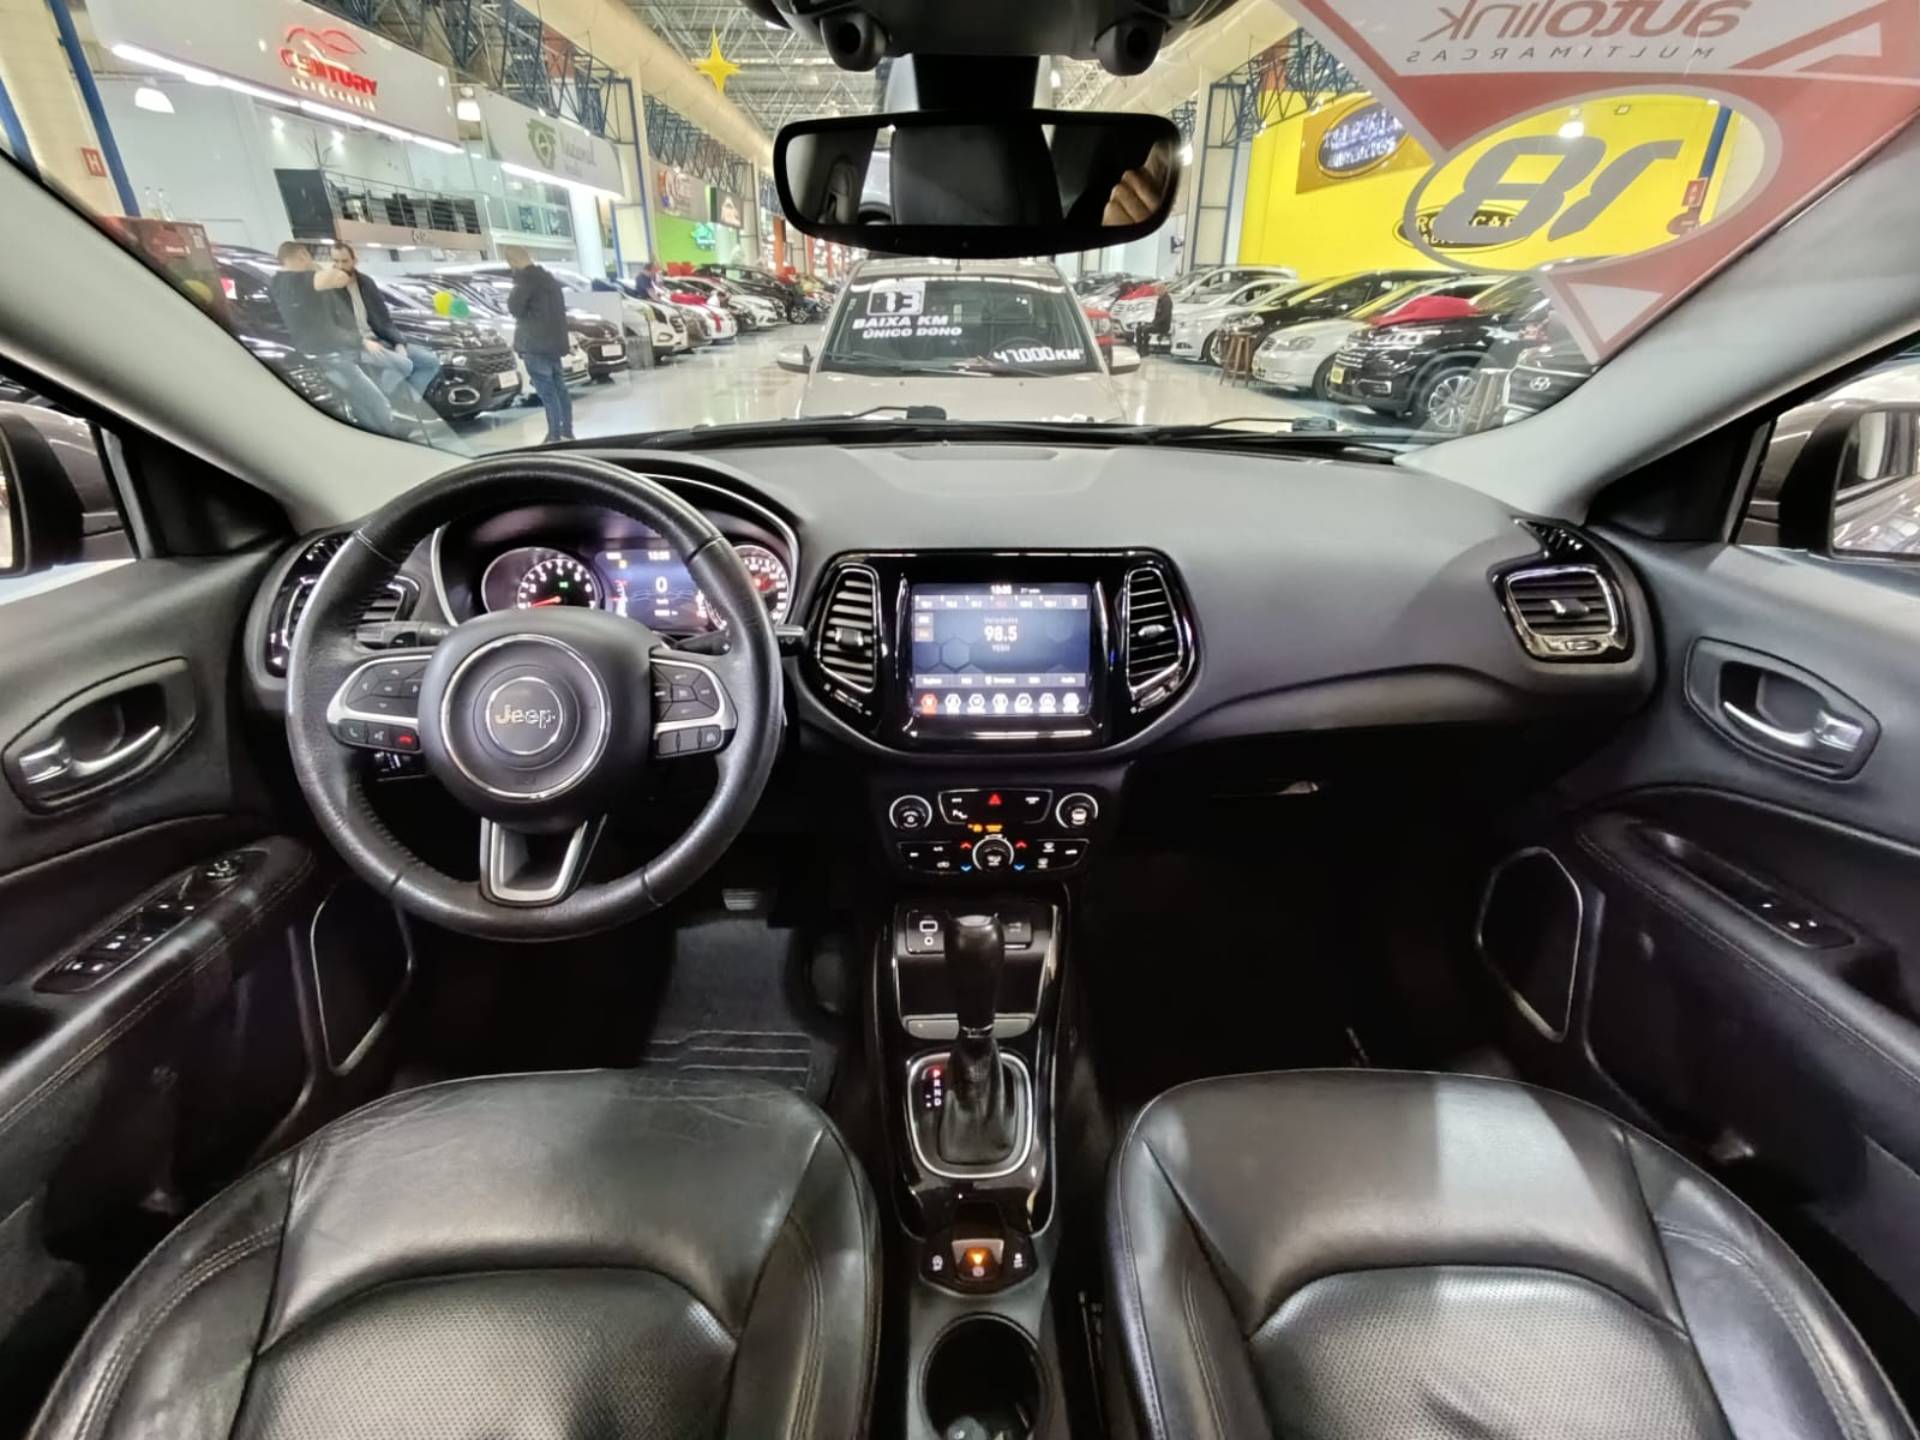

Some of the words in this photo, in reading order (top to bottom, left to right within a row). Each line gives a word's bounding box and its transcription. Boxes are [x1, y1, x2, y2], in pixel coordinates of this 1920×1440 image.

[885, 291, 922, 315] 13
[852, 316, 912, 330] BAIXA
[917, 315, 948, 326] KM
[862, 327, 913, 339] ÚNICO
[916, 326, 962, 337] DONO
[655, 575, 668, 594] 0
[984, 625, 1018, 642] 98.5
[495, 704, 556, 728] Jeep
